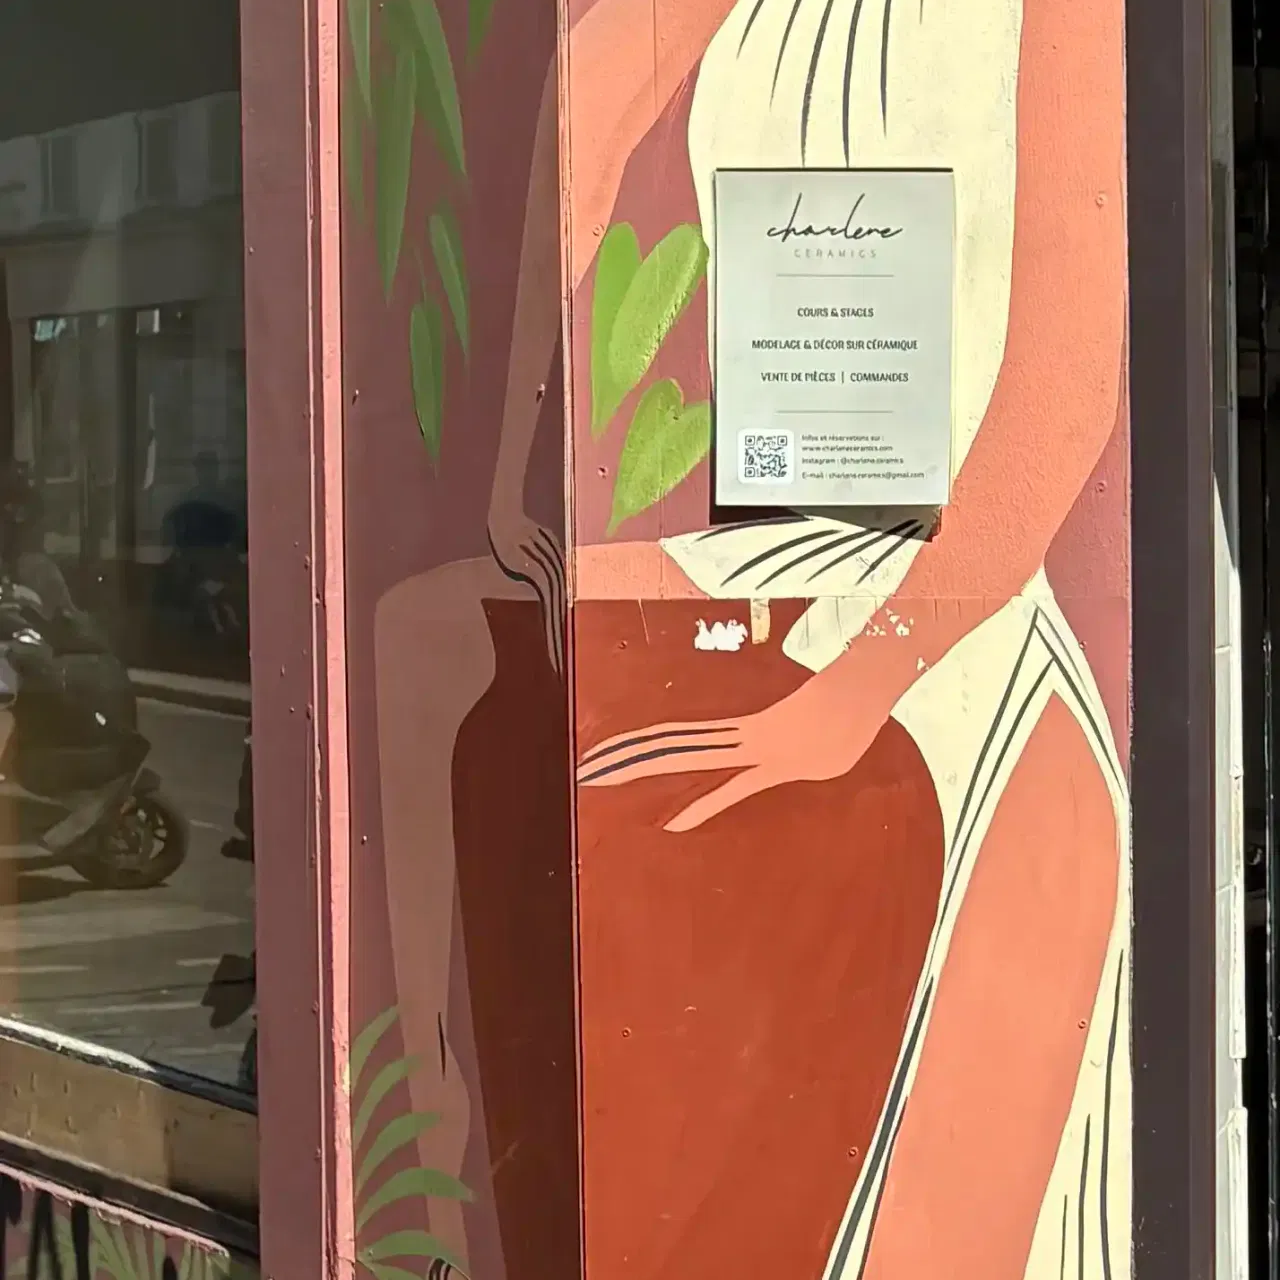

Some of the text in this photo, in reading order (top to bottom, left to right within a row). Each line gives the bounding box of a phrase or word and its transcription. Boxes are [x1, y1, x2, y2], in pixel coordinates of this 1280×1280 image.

[766, 192, 903, 242] charlene
[793, 248, 877, 259] CERAMICS
[797, 307, 829, 318] COURS
[840, 307, 875, 318] STAGES
[751, 339, 801, 350] MODELAGE
[813, 338, 845, 350] DÉCOR
[846, 339, 865, 350] SUR
[866, 338, 919, 351] CÉRAMIQUE
[760, 370, 910, 382] VENTE DE PIÈCES COMMANDES
